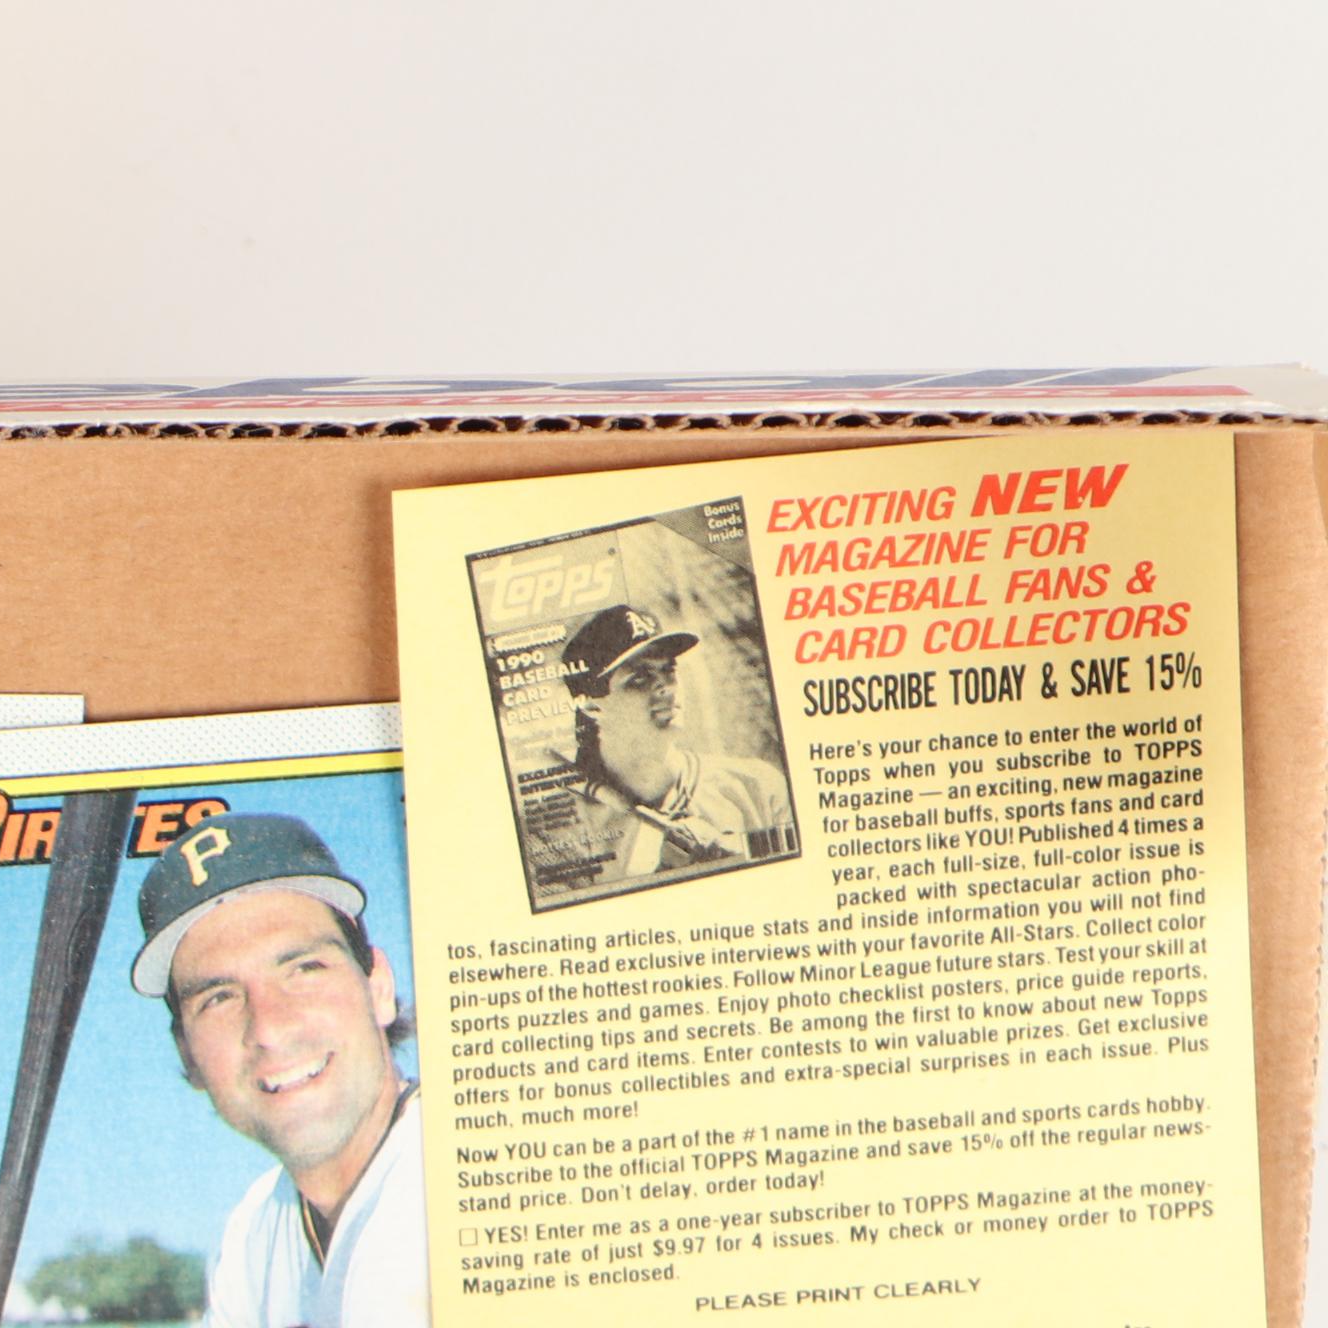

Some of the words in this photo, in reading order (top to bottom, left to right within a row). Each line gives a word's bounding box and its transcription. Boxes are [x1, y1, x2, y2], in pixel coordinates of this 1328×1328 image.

[212, 396, 691, 407] PICTURE
[704, 389, 1122, 401] CARDS
[703, 501, 741, 517] Bonus
[766, 485, 957, 533] EXCITING
[970, 463, 1130, 517] NEW
[707, 513, 743, 530] Cards
[708, 527, 744, 544] Inside
[775, 528, 993, 577] MAGAZINE
[1003, 520, 1090, 560] FOR
[784, 573, 988, 621] BASEBALL
[1004, 563, 1112, 604] FANS
[1125, 560, 1157, 595] &
[795, 624, 907, 664] CARD
[923, 601, 1192, 654] COLLECTORS
[497, 650, 545, 673] 1990
[499, 659, 590, 690] BASEBALL
[502, 686, 551, 708] CARD
[803, 671, 937, 717] SUBSCRIBE
[948, 664, 1027, 706] TODAY
[1040, 661, 1058, 700] &
[1070, 656, 1131, 698] SAVE
[1145, 651, 1202, 692] 15%
[809, 740, 873, 761] Here's
[878, 739, 922, 759] your
[928, 733, 998, 752] chance
[1004, 729, 1023, 747] to
[1029, 725, 1081, 745] enter
[1085, 721, 1117, 741] the
[1121, 715, 1178, 738] world
[1183, 713, 1203, 734] of
[813, 767, 871, 788] Topps
[883, 761, 936, 780] when
[948, 759, 984, 779] you
[996, 747, 1092, 772] subscribe
[1103, 746, 1123, 764] to
[1133, 738, 1203, 762] TOPPS
[180, 825, 233, 887] P
[827, 837, 922, 858] collectors
[926, 832, 960, 851] like
[964, 827, 1014, 848] YOU!
[1018, 819, 1114, 844] Published
[1117, 818, 1130, 837] 4
[1133, 817, 1189, 836] times
[1192, 816, 1205, 832] a
[695, 1291, 788, 1312] PLEASE
[796, 1285, 865, 1305] PRINT
[873, 1277, 981, 1300] CLEARLY
